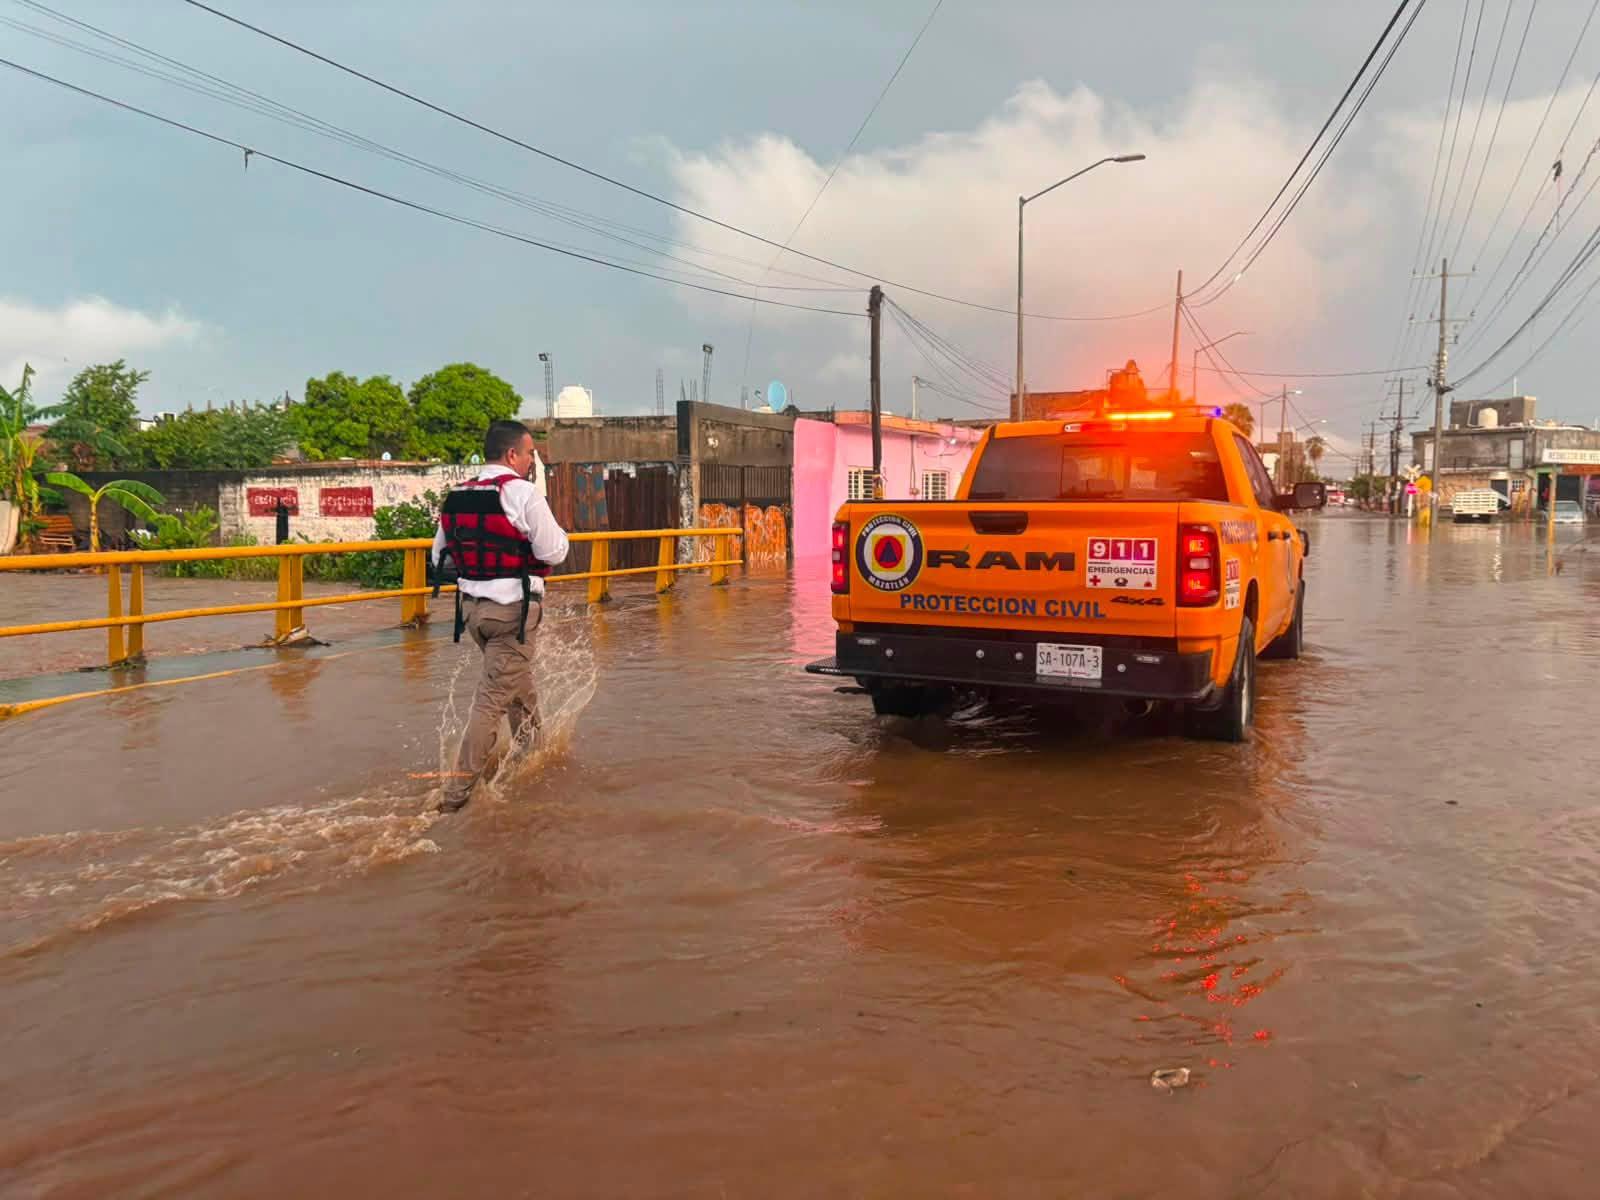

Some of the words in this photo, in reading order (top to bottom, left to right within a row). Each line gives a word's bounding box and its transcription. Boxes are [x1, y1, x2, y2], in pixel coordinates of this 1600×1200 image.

[902, 519, 918, 538] CIVIL
[1093, 542, 1149, 559] 911
[927, 550, 1076, 571] RAM
[1088, 565, 1155, 575] EMERGENCIAS
[900, 593, 1037, 615] PROTECCION
[1045, 600, 1106, 619] CIVIL
[1039, 651, 1100, 669] SA-107A-3
